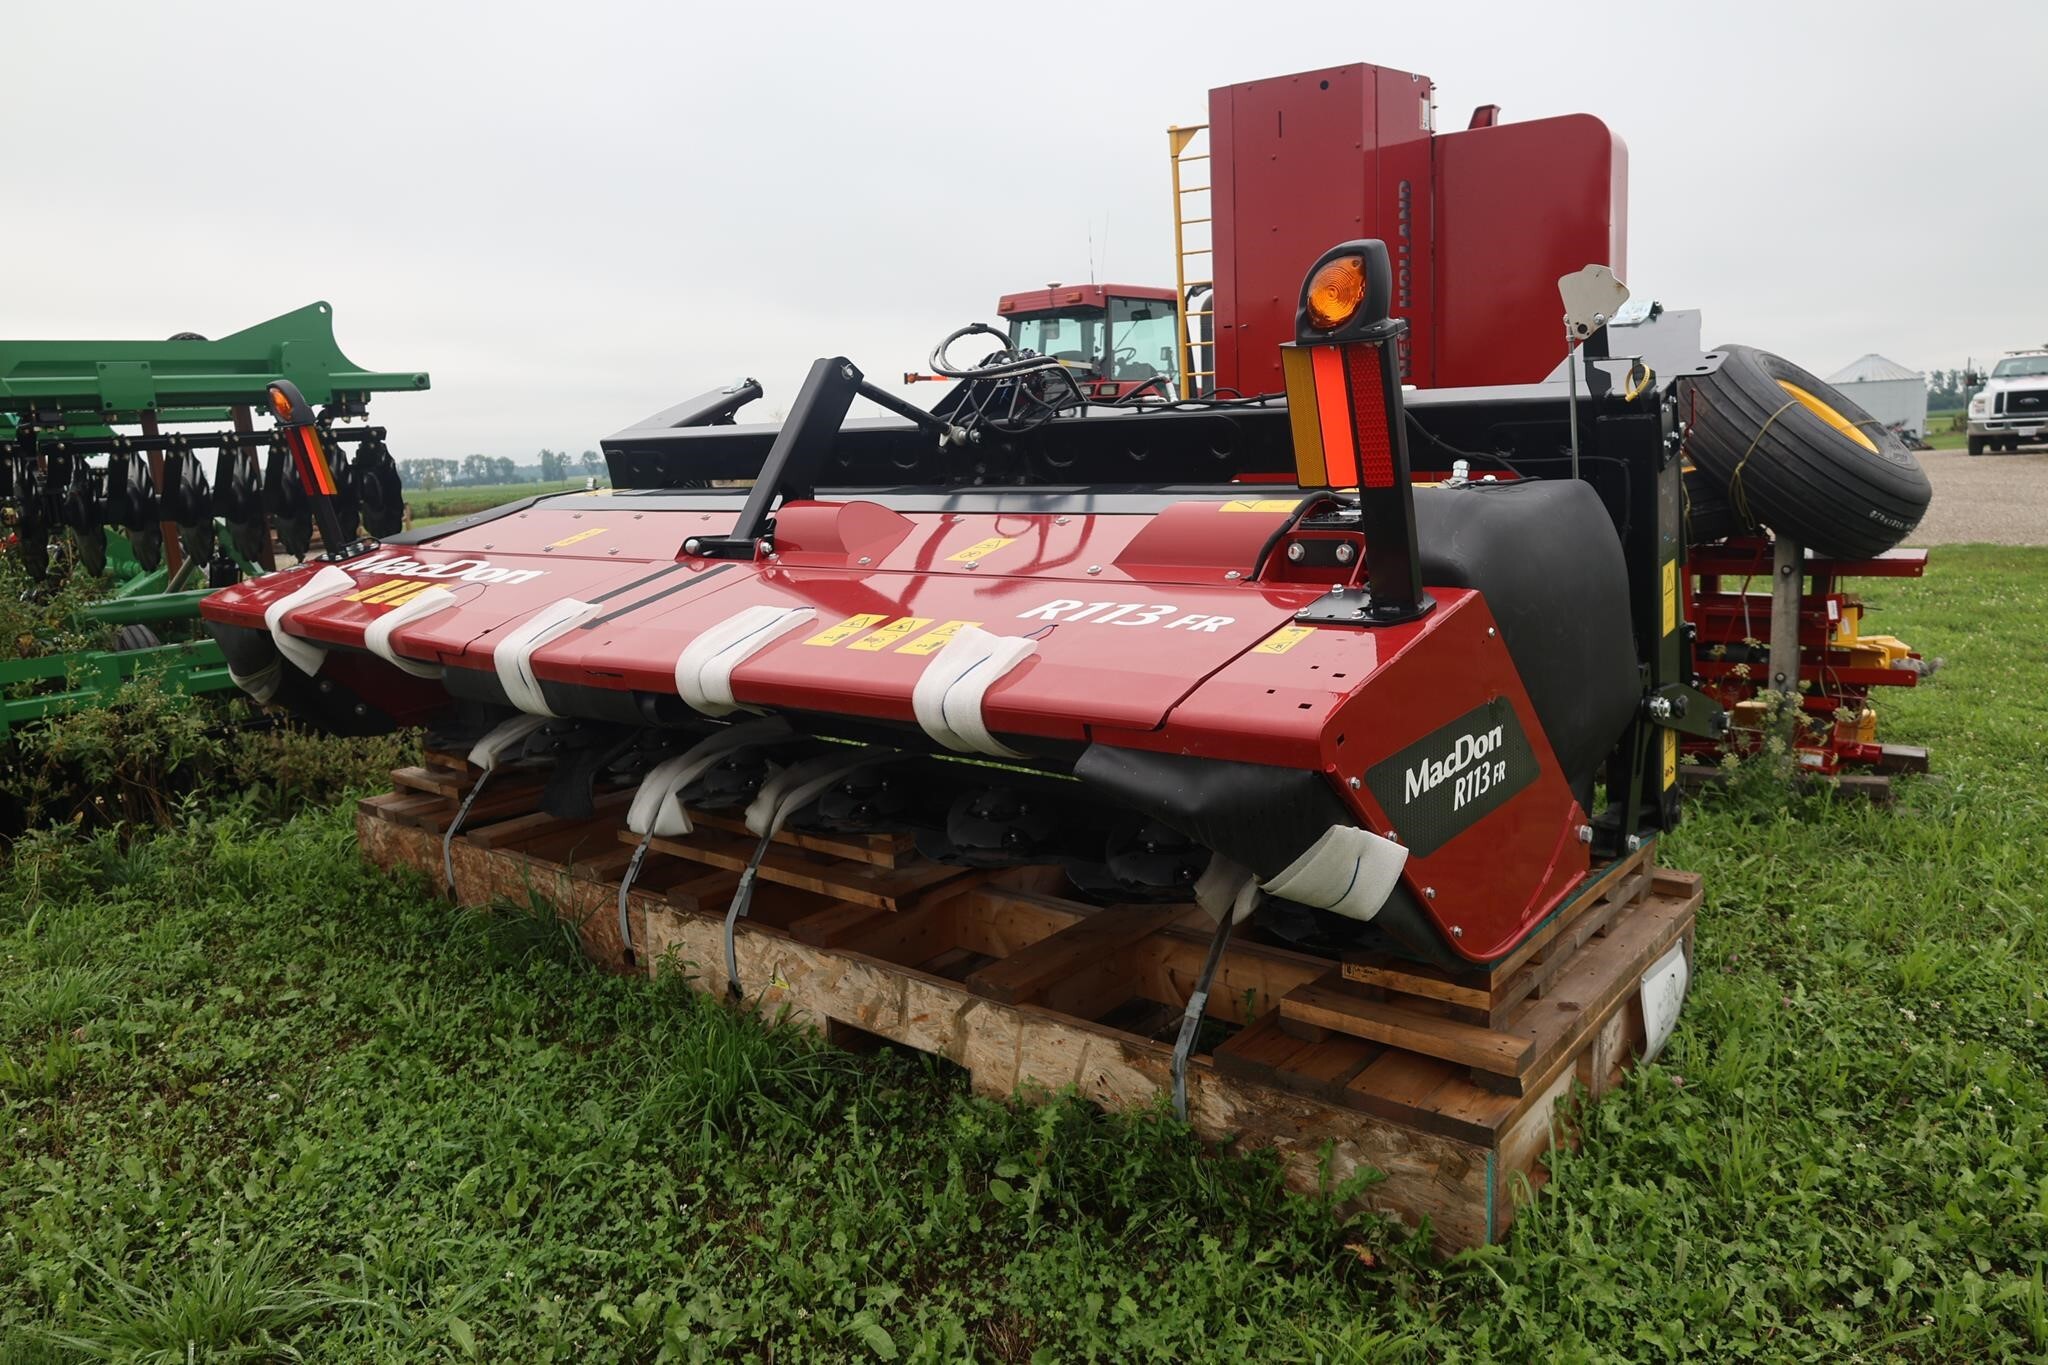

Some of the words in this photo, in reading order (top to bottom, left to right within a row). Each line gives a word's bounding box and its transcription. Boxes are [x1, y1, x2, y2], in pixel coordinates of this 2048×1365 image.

[1398, 180, 1411, 308] HOLLAND
[340, 553, 545, 585] MacDon
[1016, 599, 1178, 626] R113
[1163, 614, 1236, 632] FR
[1405, 725, 1502, 804] MacDon
[1453, 761, 1490, 811] R113
[1493, 760, 1506, 786] FR
